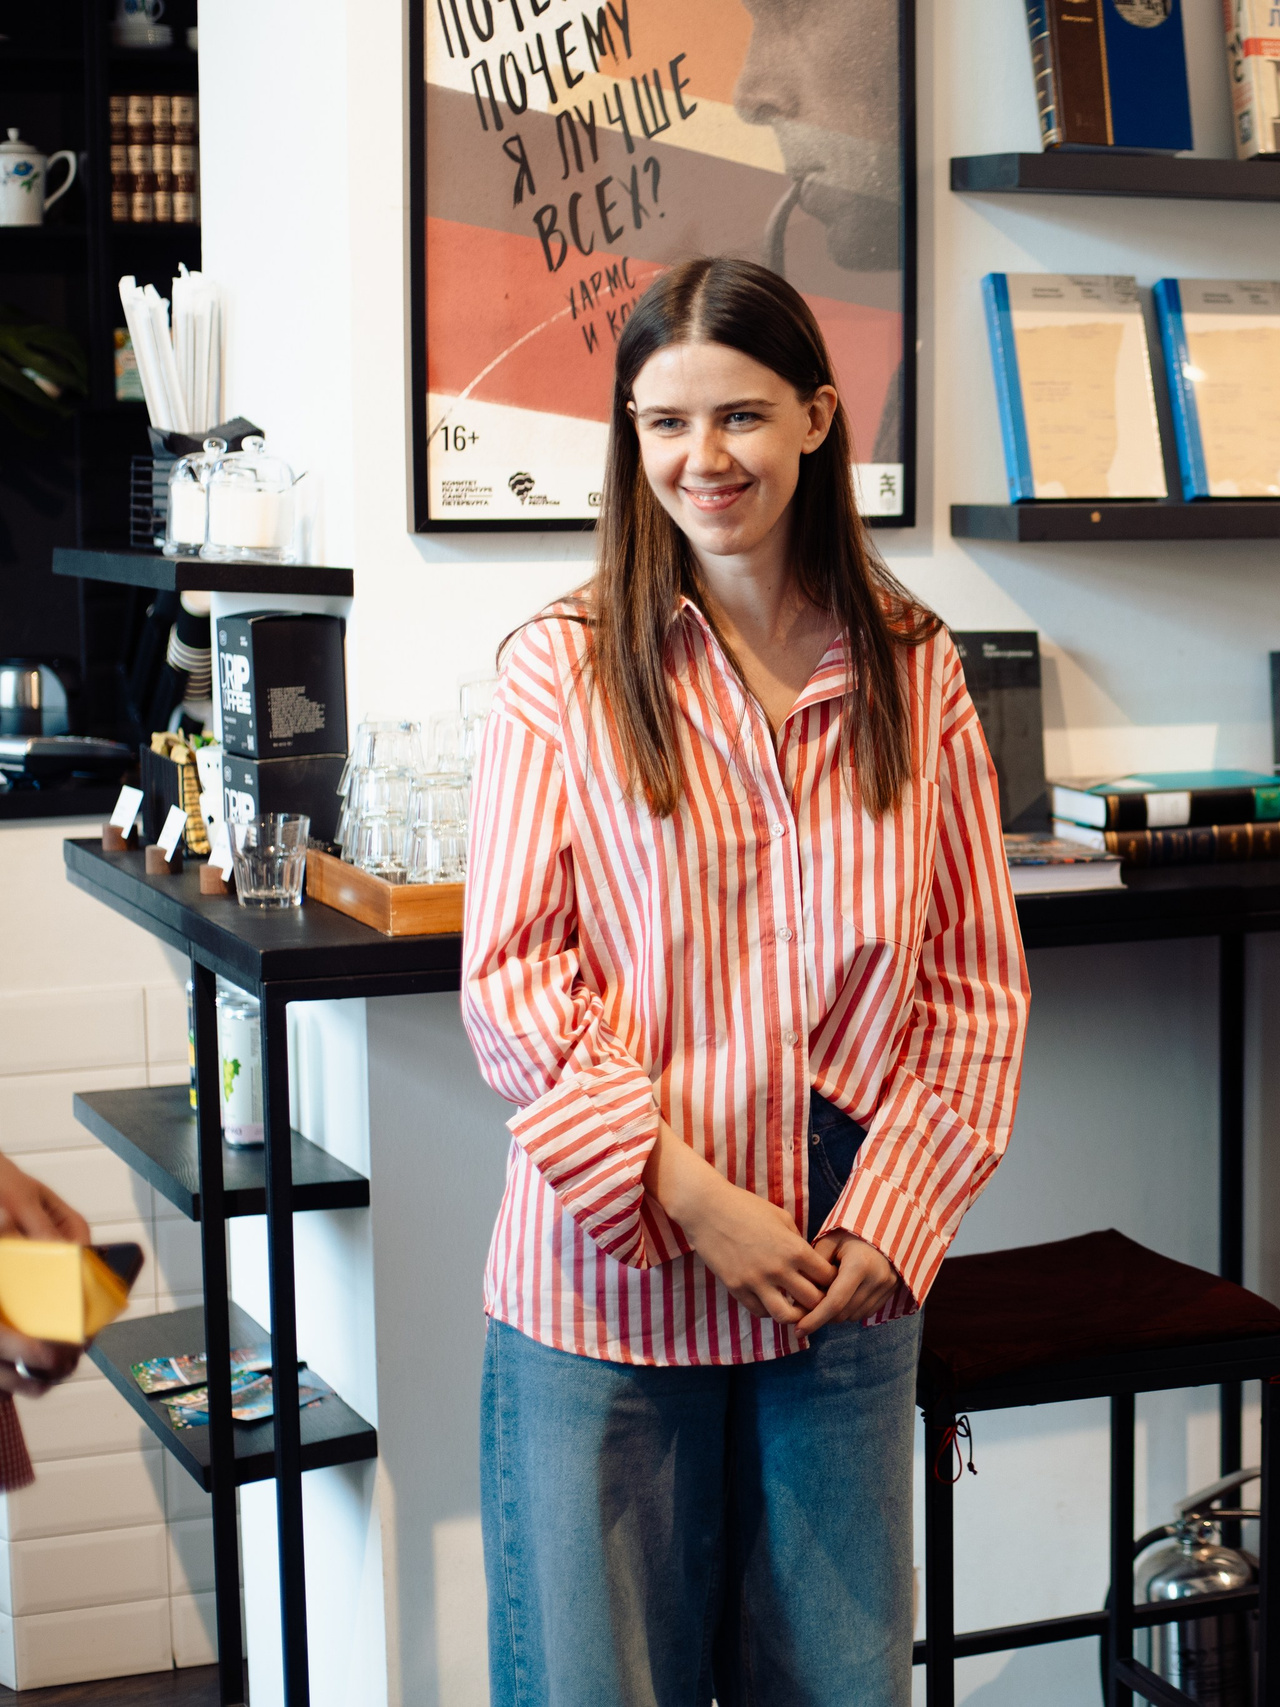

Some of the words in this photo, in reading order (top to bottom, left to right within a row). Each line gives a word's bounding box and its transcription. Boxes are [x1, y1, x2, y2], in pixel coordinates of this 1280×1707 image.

[470, 0, 633, 131] ПОЧЕМУ
[502, 132, 536, 209] Я
[555, 52, 697, 180] ЛУЧШЕ
[532, 156, 665, 272] ВСЕХ?
[563, 256, 636, 320] ХАРМС
[582, 321, 600, 354] И
[606, 296, 638, 342] КО
[440, 425, 480, 451] 16+
[219, 652, 251, 693] DRIP
[221, 688, 252, 715] COFFEE
[224, 787, 256, 825] DRIP
